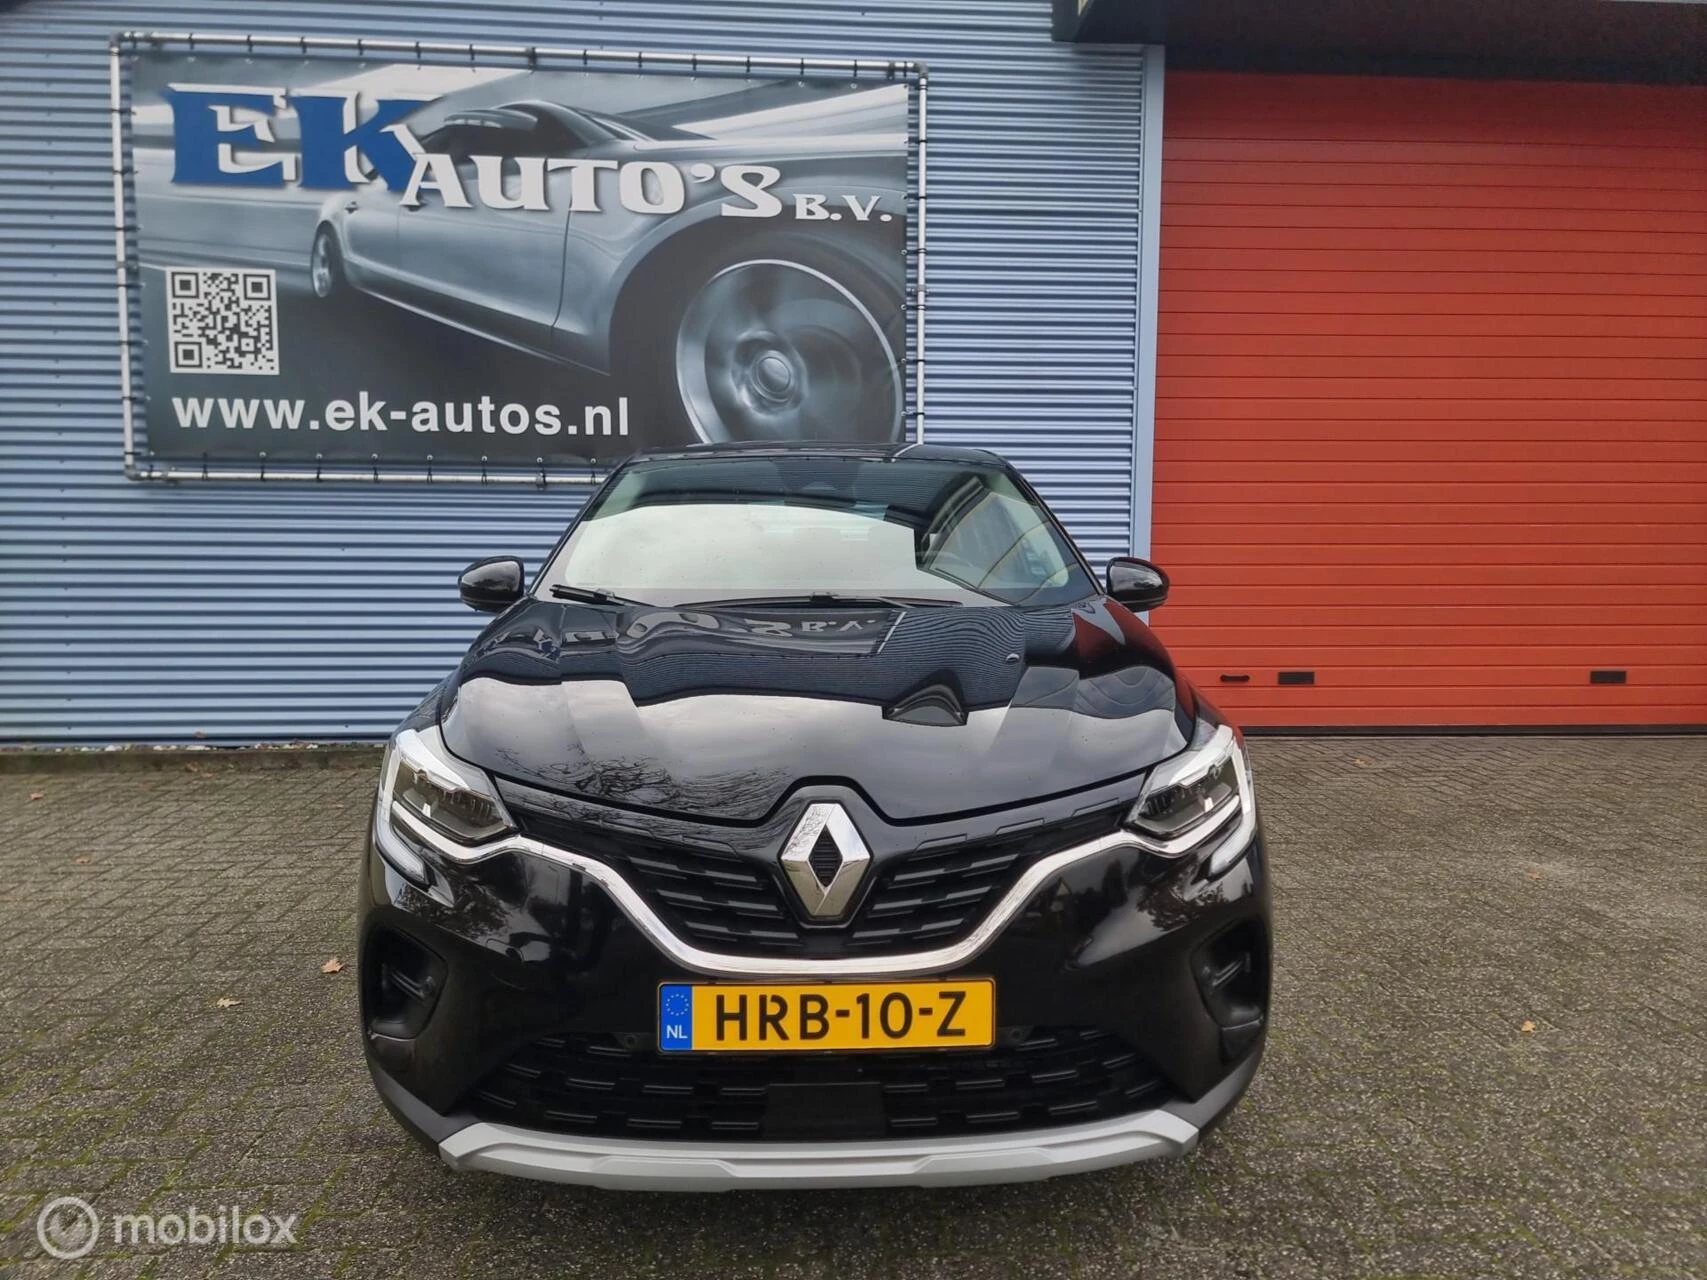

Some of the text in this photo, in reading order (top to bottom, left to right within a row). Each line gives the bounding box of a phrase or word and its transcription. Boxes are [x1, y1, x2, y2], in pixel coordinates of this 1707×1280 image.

[164, 82, 443, 192] EK
[794, 192, 893, 222] B.V.
[171, 391, 629, 436] www.ek-autos.nl
[666, 1024, 688, 1039] NL
[715, 990, 967, 1041] HRB-10-Z
